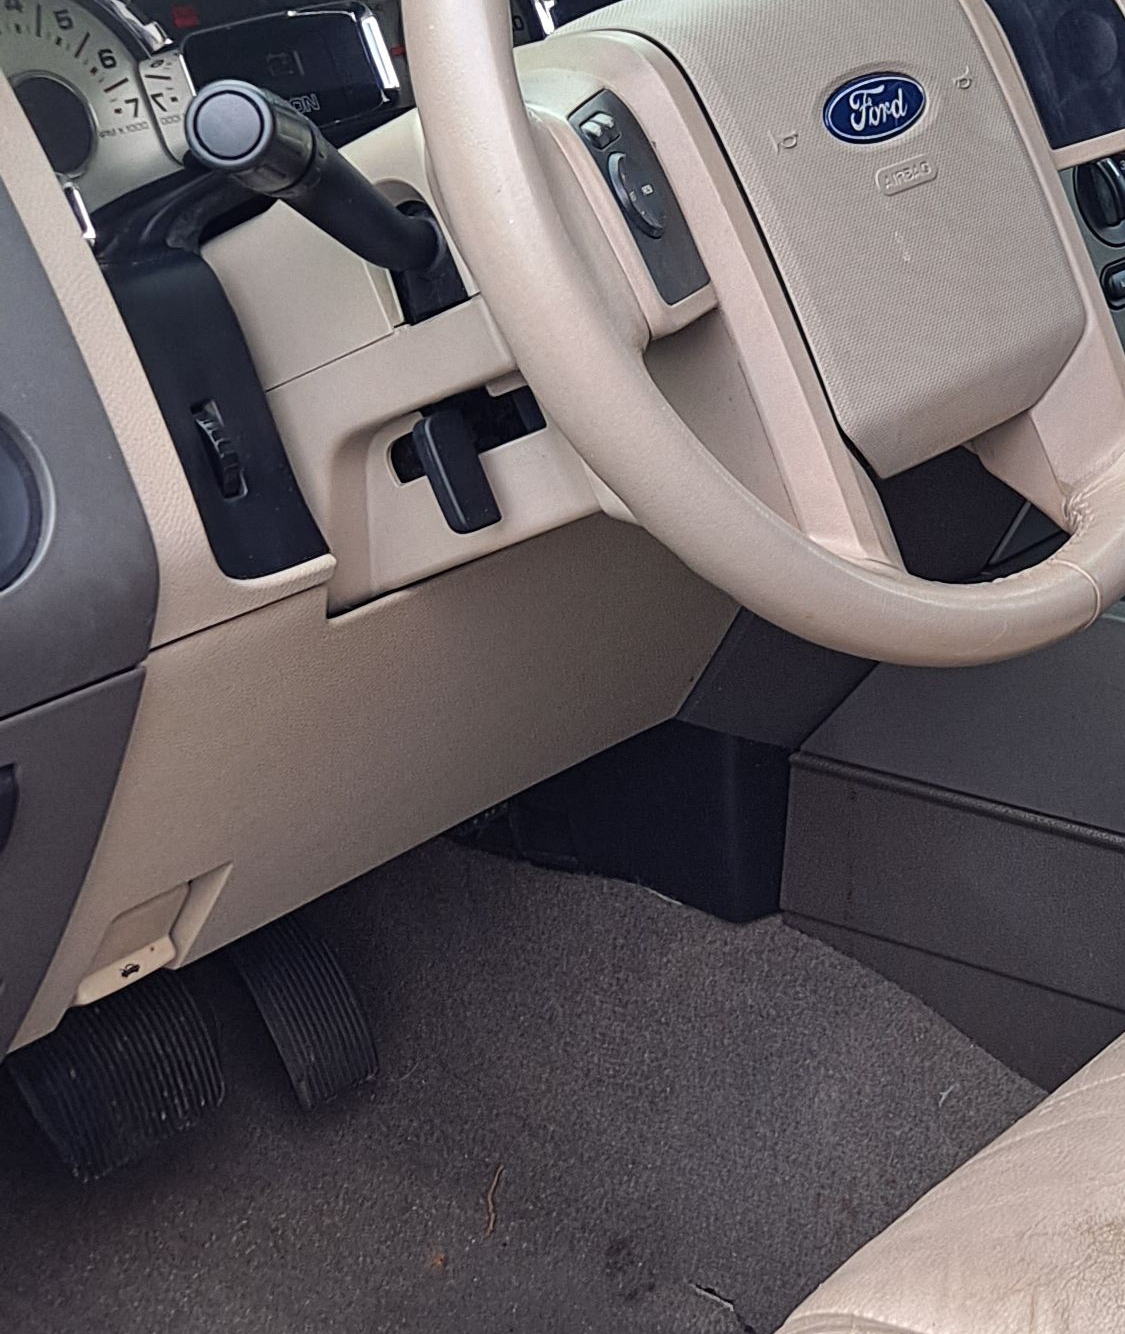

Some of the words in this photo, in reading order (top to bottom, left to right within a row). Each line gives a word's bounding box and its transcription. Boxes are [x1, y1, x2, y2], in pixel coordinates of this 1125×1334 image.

[53, 9, 74, 31] 5
[98, 48, 117, 69] 6
[124, 97, 139, 118] 7
[849, 84, 908, 132] Ford
[883, 160, 933, 190] AIRBAG
